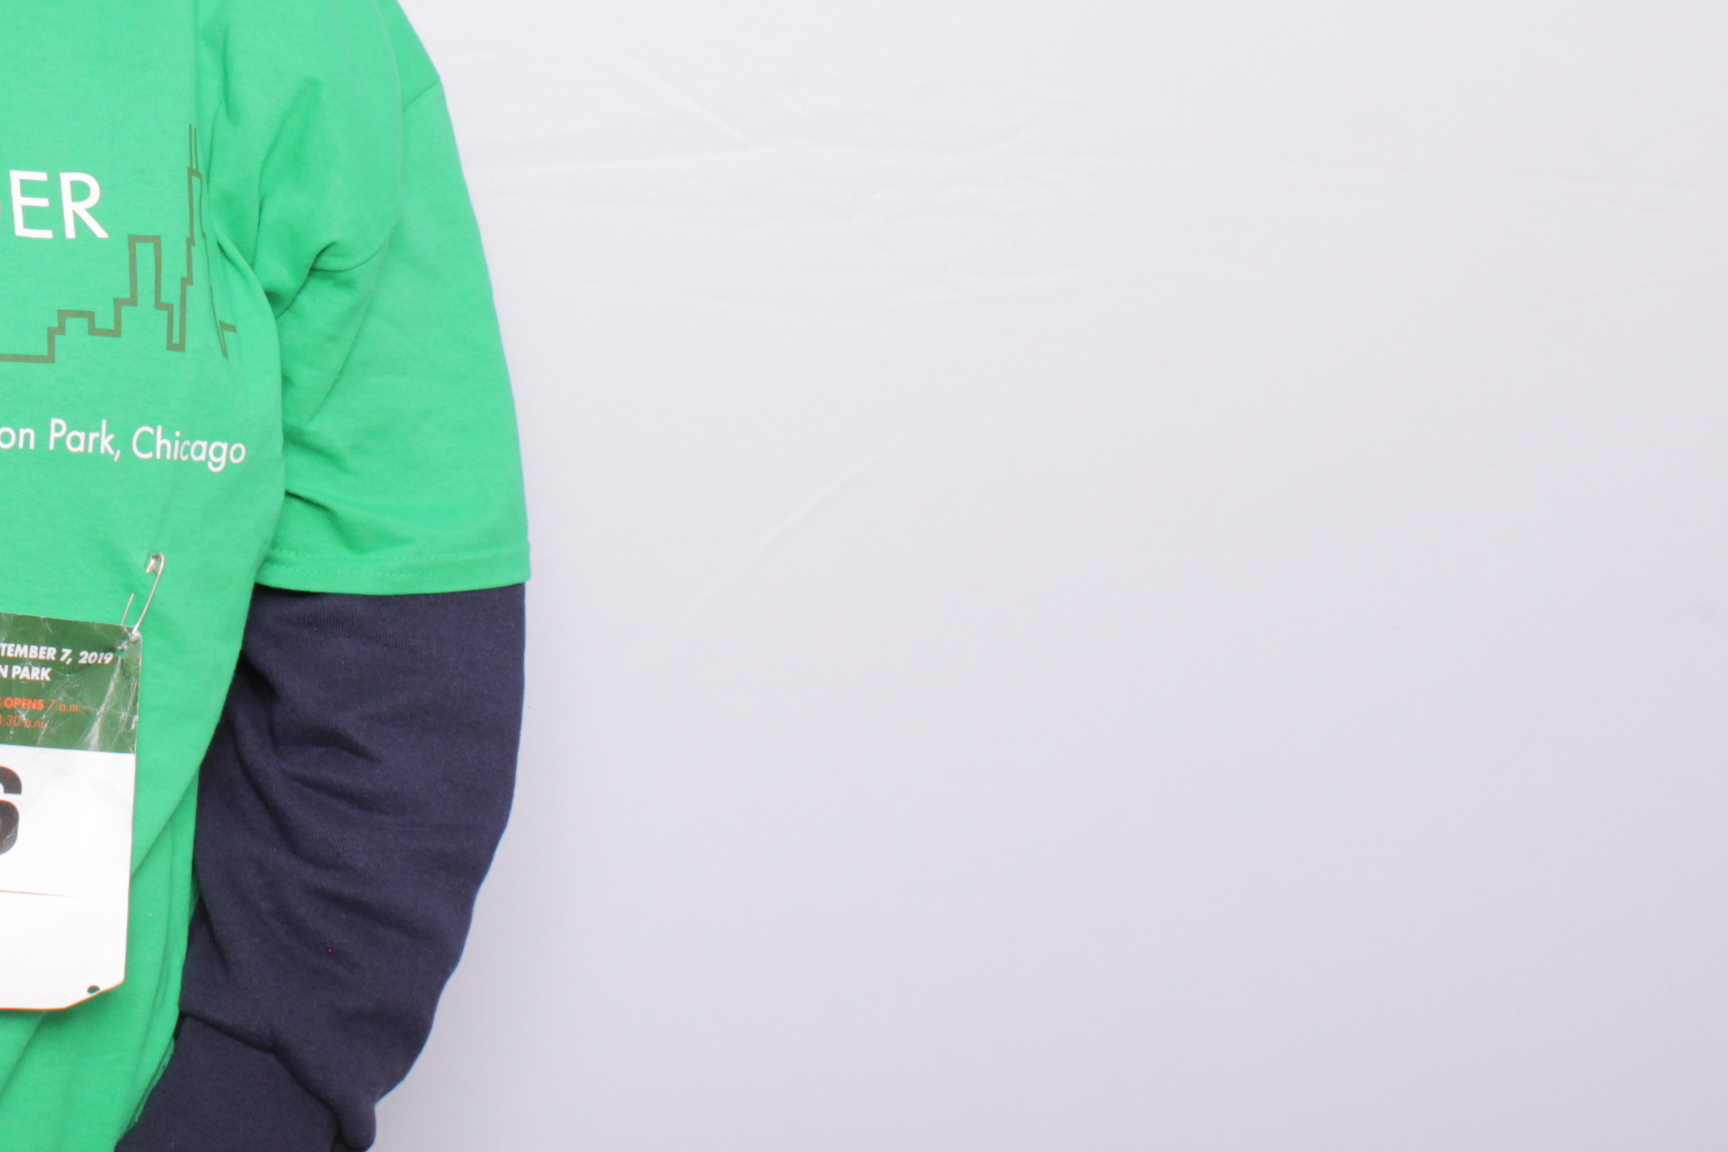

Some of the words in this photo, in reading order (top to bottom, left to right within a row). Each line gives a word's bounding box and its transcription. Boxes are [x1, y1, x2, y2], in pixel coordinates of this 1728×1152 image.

[49, 418, 121, 462] Park,
[132, 425, 246, 473] Chicago
[59, 648, 73, 665] 7,
[77, 650, 114, 665] 2019
[11, 665, 52, 681] PARK
[3, 696, 44, 711] OPENS
[47, 699, 56, 711] 7
[59, 701, 82, 713] a.m.
